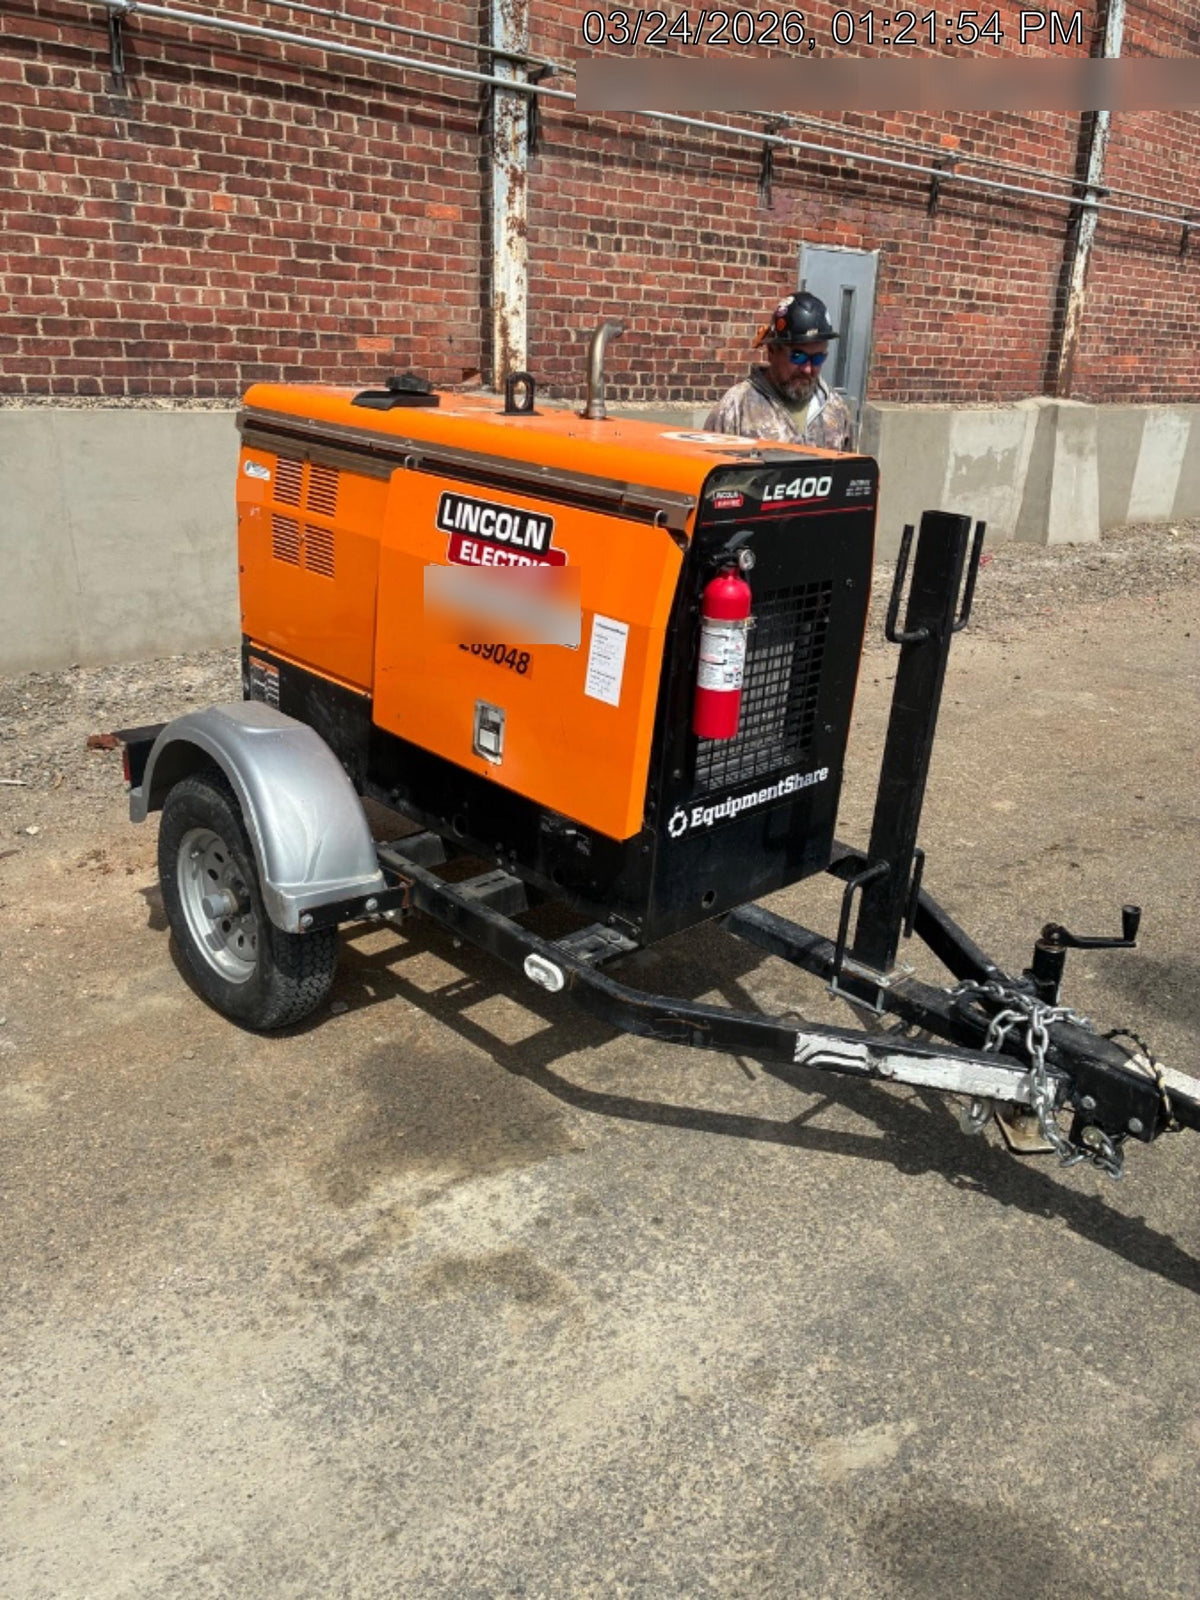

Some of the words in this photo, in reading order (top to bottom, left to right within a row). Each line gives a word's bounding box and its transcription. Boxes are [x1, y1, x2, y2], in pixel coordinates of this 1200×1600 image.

[762, 476, 833, 502] LE400
[442, 499, 547, 550] LINCOLN
[460, 540, 551, 566] ELECT
[459, 643, 531, 675] 9048
[690, 767, 830, 827] EquipmentShare
